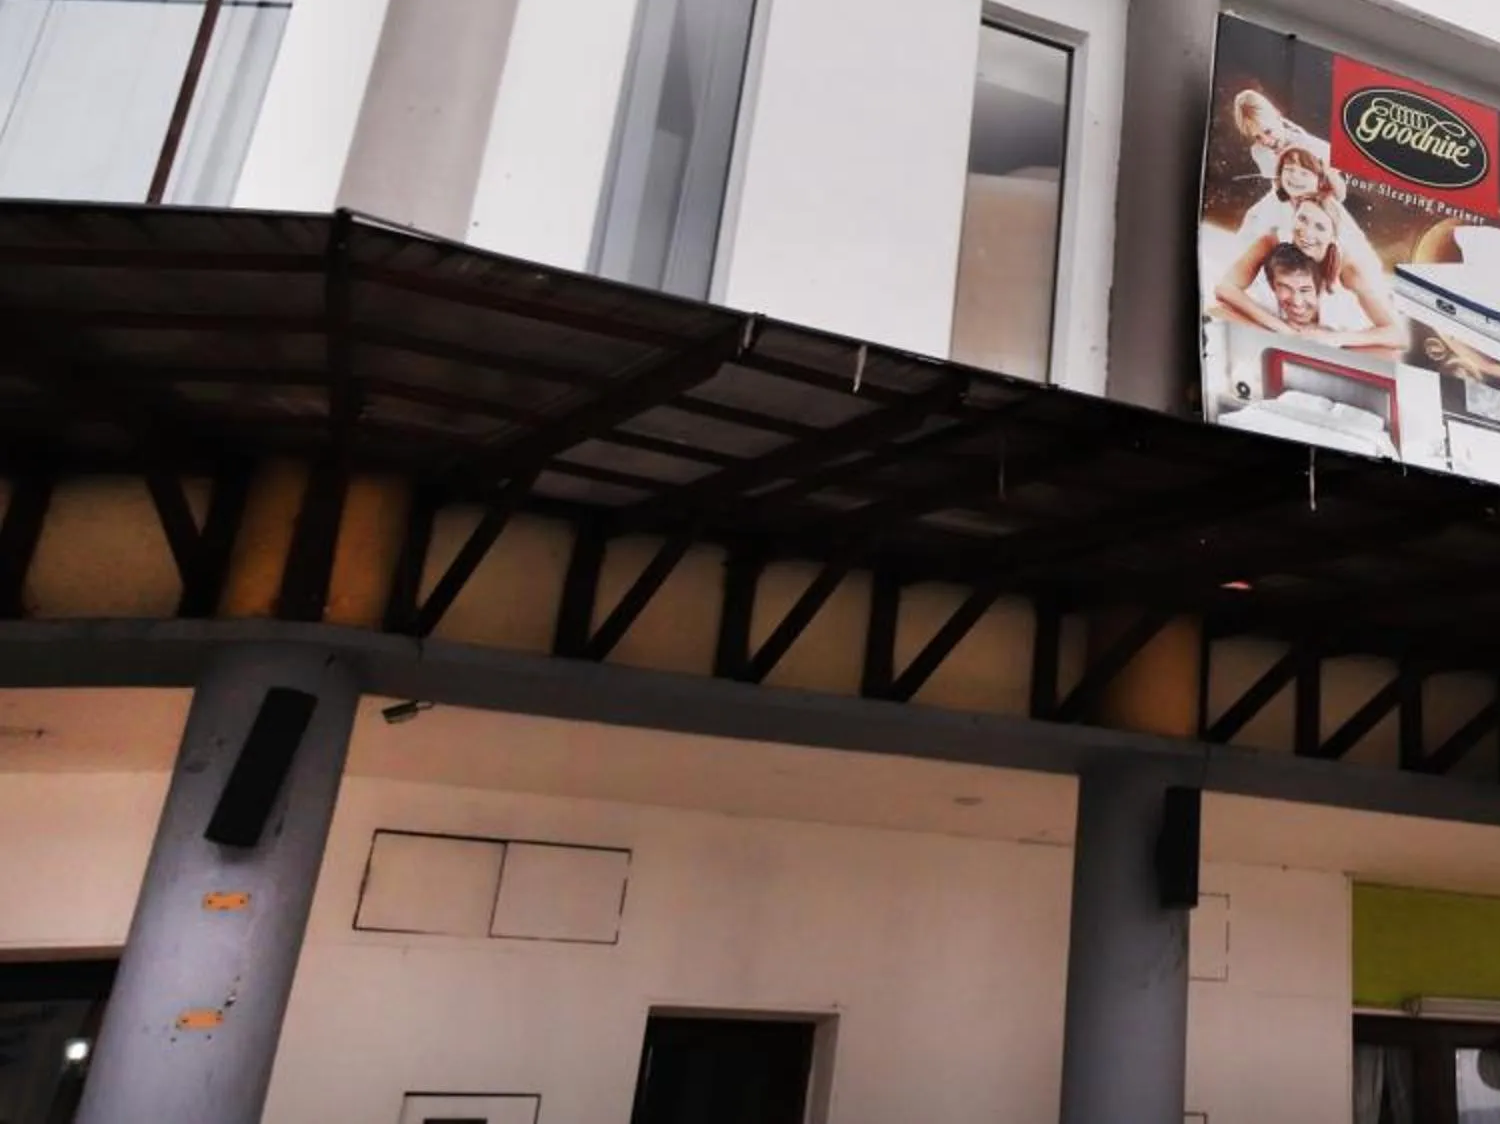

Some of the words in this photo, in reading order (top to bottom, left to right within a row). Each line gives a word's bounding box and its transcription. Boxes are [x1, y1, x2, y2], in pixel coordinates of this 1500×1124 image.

[1355, 98, 1471, 168] Goodnite
[1344, 173, 1374, 191] Your
[1378, 180, 1435, 215] Sleeping
